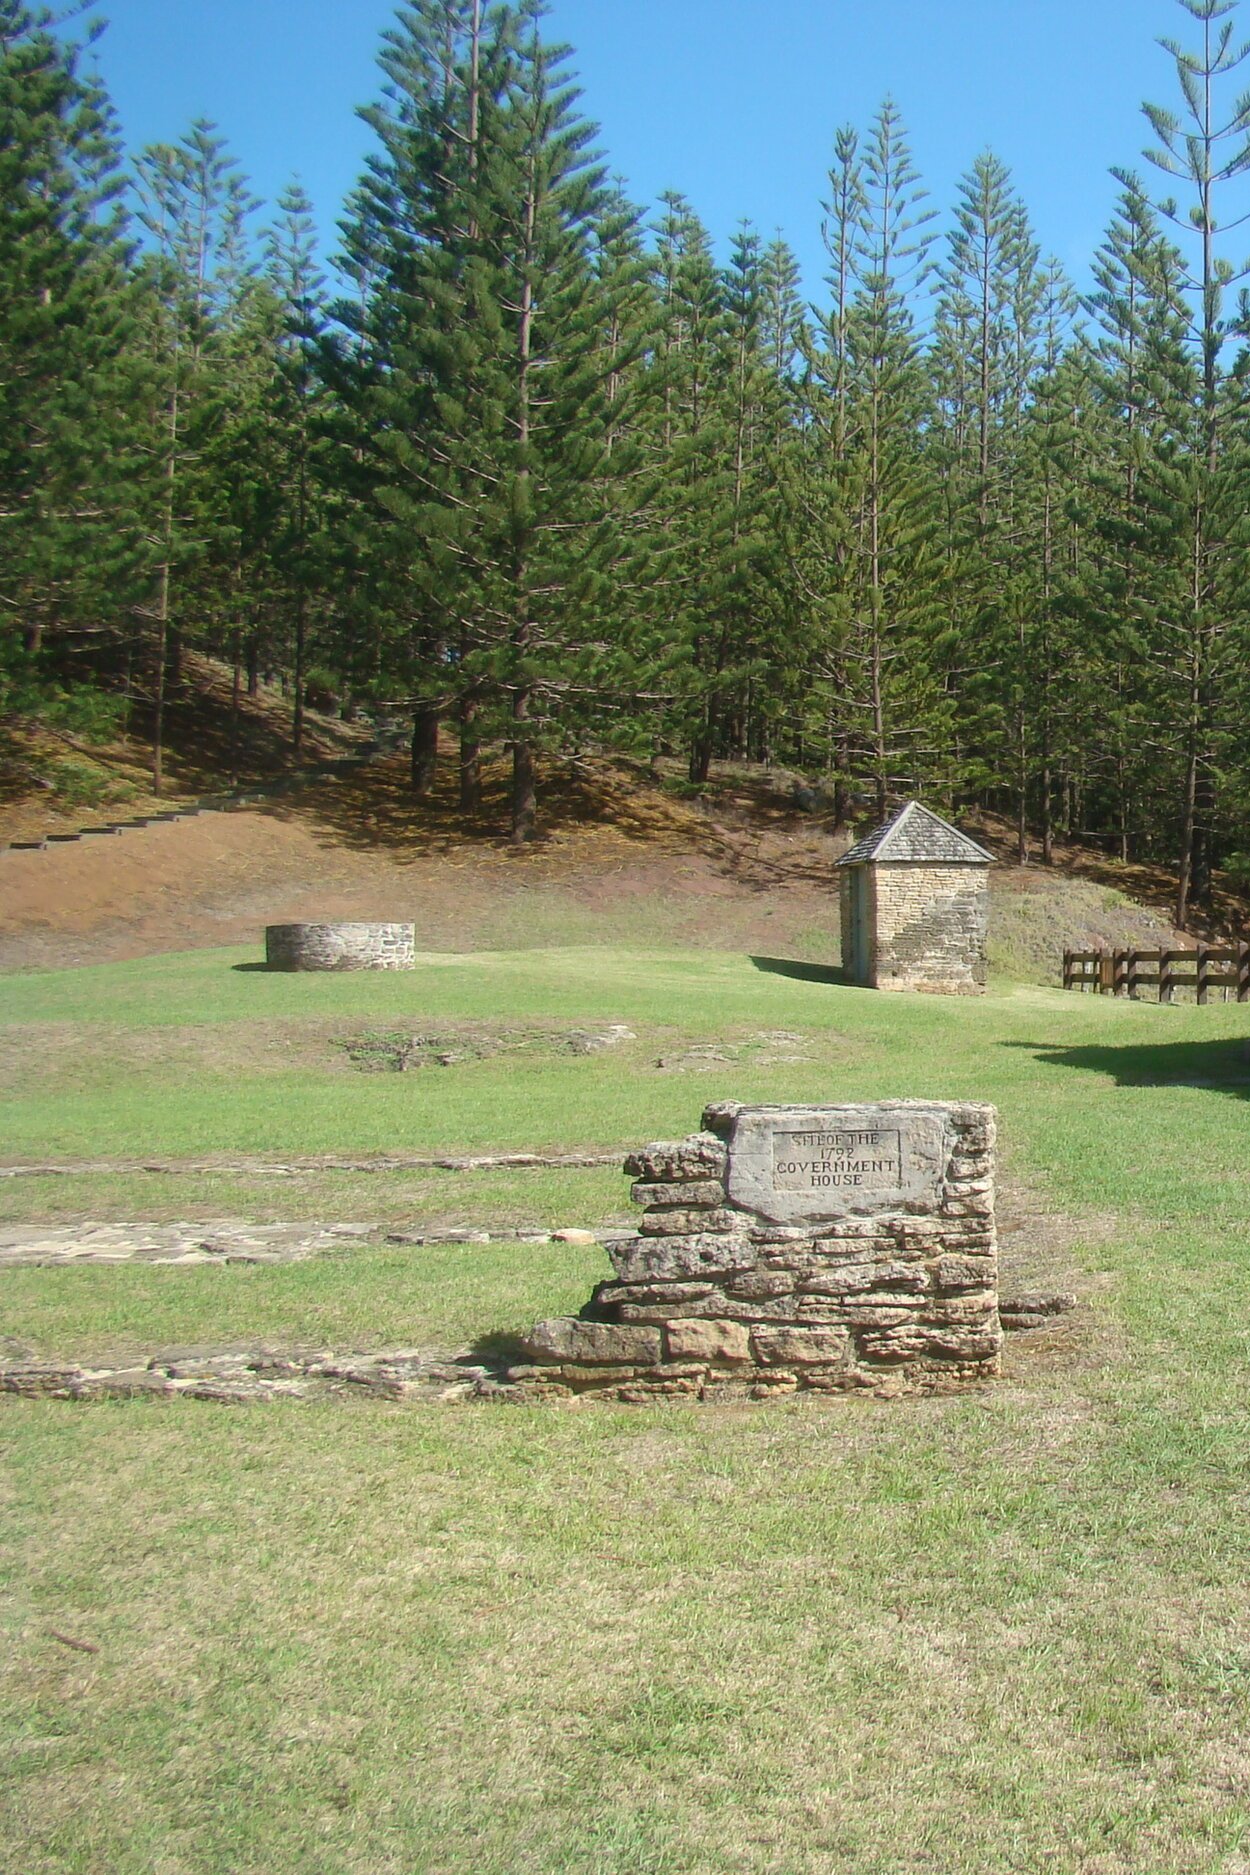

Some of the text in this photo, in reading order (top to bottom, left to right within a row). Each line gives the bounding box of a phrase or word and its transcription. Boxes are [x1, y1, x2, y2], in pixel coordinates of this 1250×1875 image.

[826, 1134, 845, 1146] OF
[847, 1132, 880, 1145] THE
[820, 1147, 855, 1160] 1792
[776, 1160, 896, 1174] GOVERNMENT
[811, 1174, 864, 1187] HOUSE
